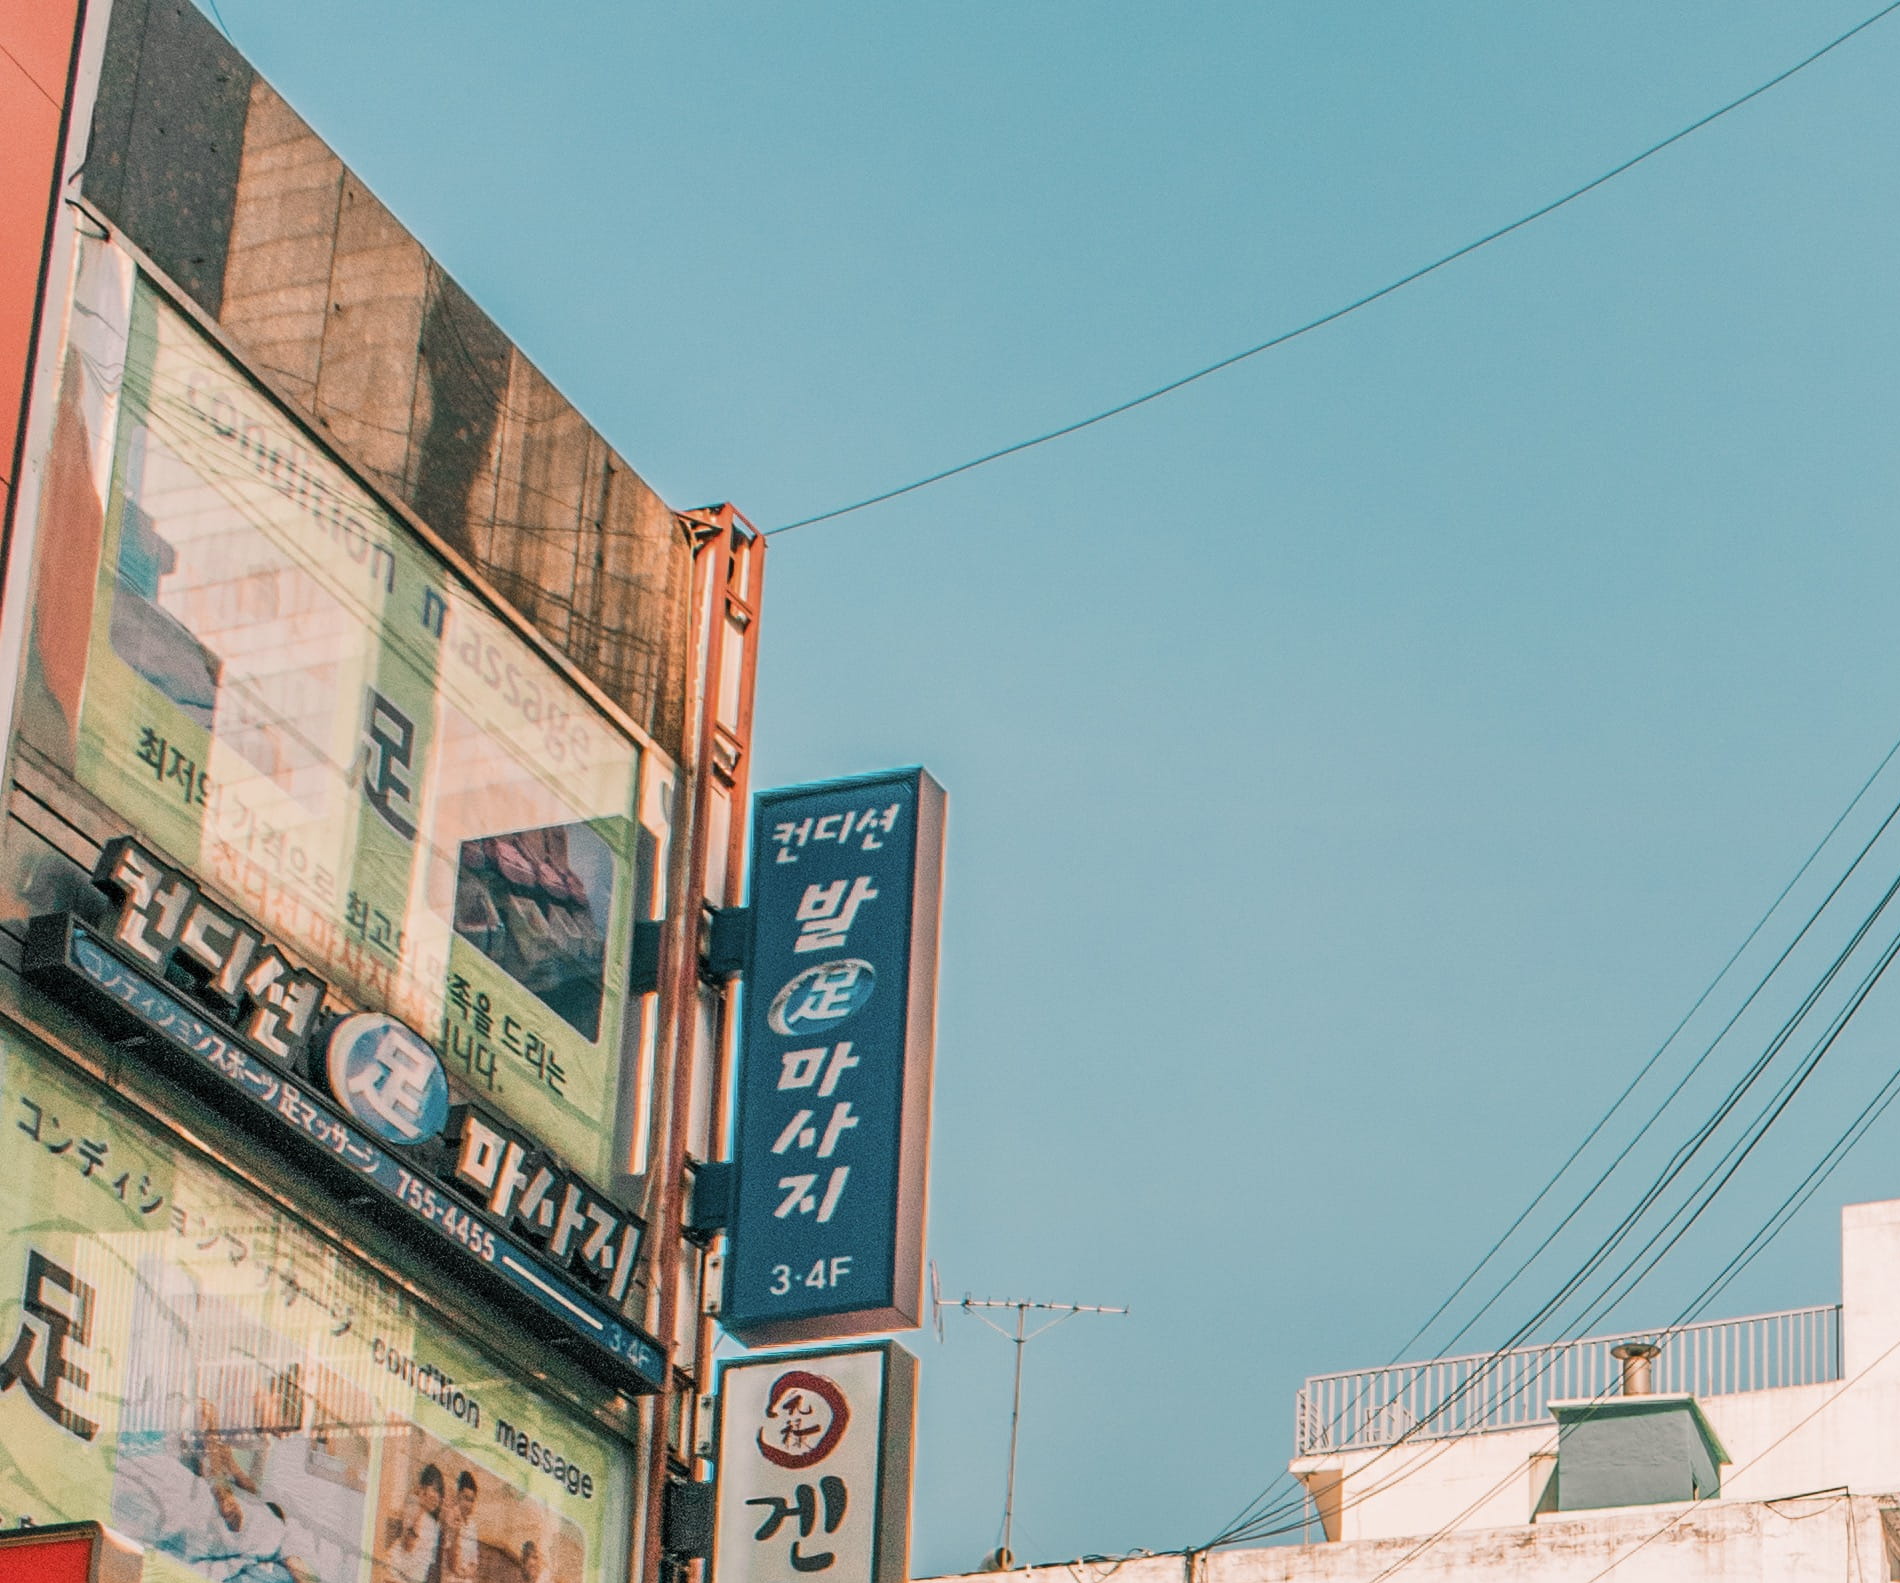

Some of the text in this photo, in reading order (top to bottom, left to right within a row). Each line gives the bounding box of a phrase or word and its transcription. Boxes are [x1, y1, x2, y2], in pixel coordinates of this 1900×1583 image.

[773, 803, 898, 864] 컨디션
[794, 875, 877, 951] 발
[110, 848, 319, 1058] 컨디션
[457, 1114, 643, 1302] 마사지
[773, 1043, 880, 1224] 마사지
[397, 1166, 497, 1261] 755-4455
[2, 1247, 100, 1442] 足
[371, 1334, 481, 1430] condition
[496, 1406, 595, 1501] massage
